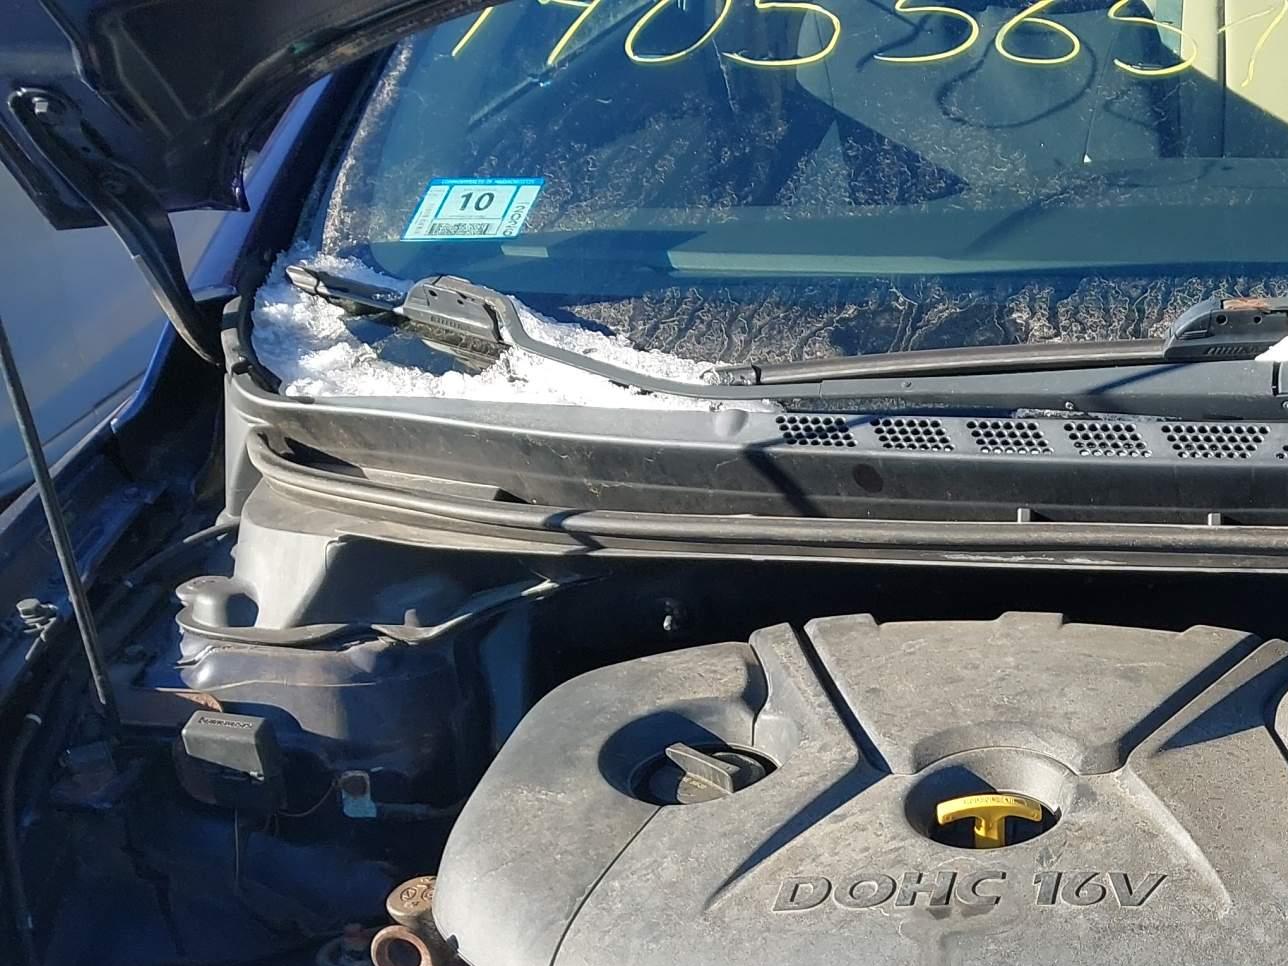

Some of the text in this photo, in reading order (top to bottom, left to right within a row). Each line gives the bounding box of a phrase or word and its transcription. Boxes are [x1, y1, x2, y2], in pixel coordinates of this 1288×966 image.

[459, 192, 495, 211] 10
[773, 871, 1168, 911] DOHC 16V
